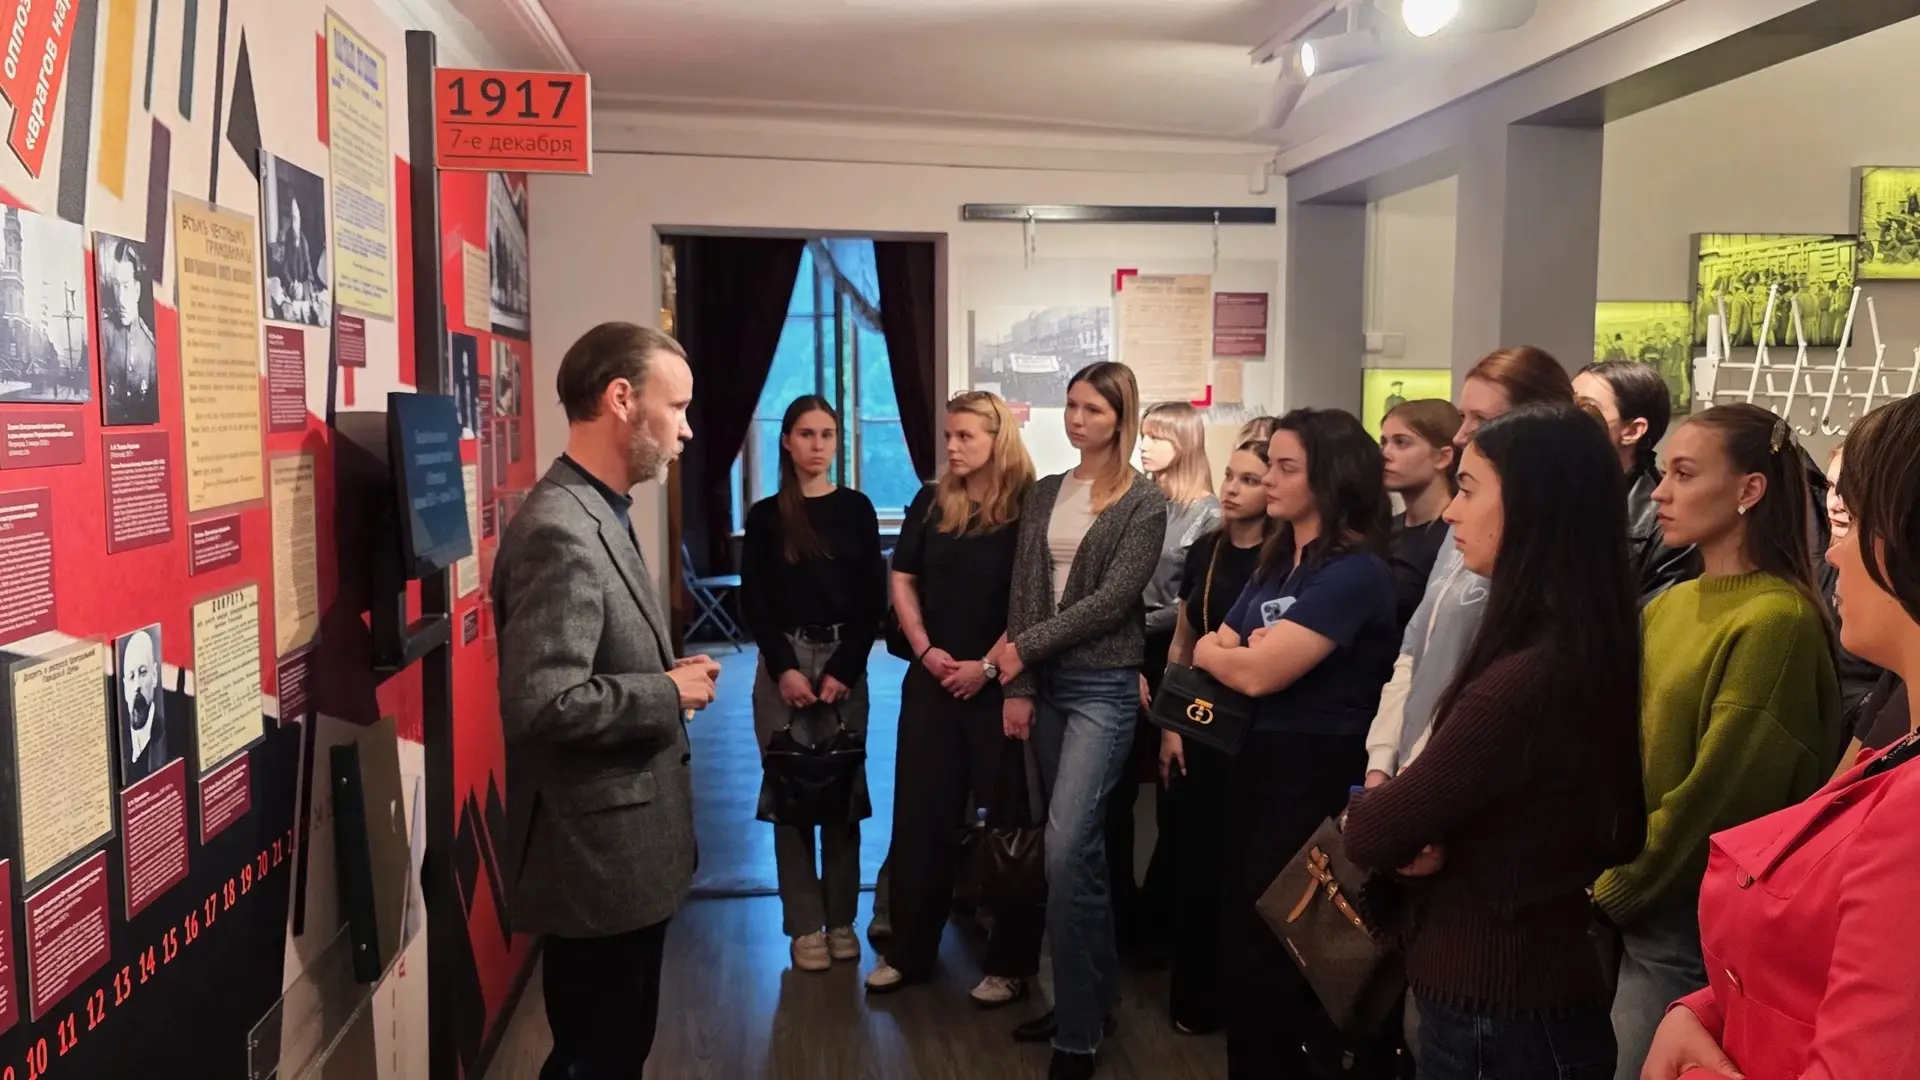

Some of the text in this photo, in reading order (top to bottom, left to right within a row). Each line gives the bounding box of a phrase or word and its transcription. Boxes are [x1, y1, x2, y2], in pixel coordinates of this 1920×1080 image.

[25, 36, 58, 150] «врагов
[448, 77, 572, 119] 1917
[450, 129, 572, 156] 7-е декабря
[26, 1038, 47, 1080] 10
[57, 1012, 78, 1056] 11
[86, 988, 105, 1031] 12
[113, 965, 131, 1007] 13
[139, 945, 156, 984] 14
[162, 926, 178, 965] 15
[184, 909, 199, 946] 16
[204, 892, 217, 928] 17
[223, 878, 236, 911] 18
[240, 863, 252, 895] 19
[257, 850, 268, 881] 20
[272, 838, 284, 867] 21
